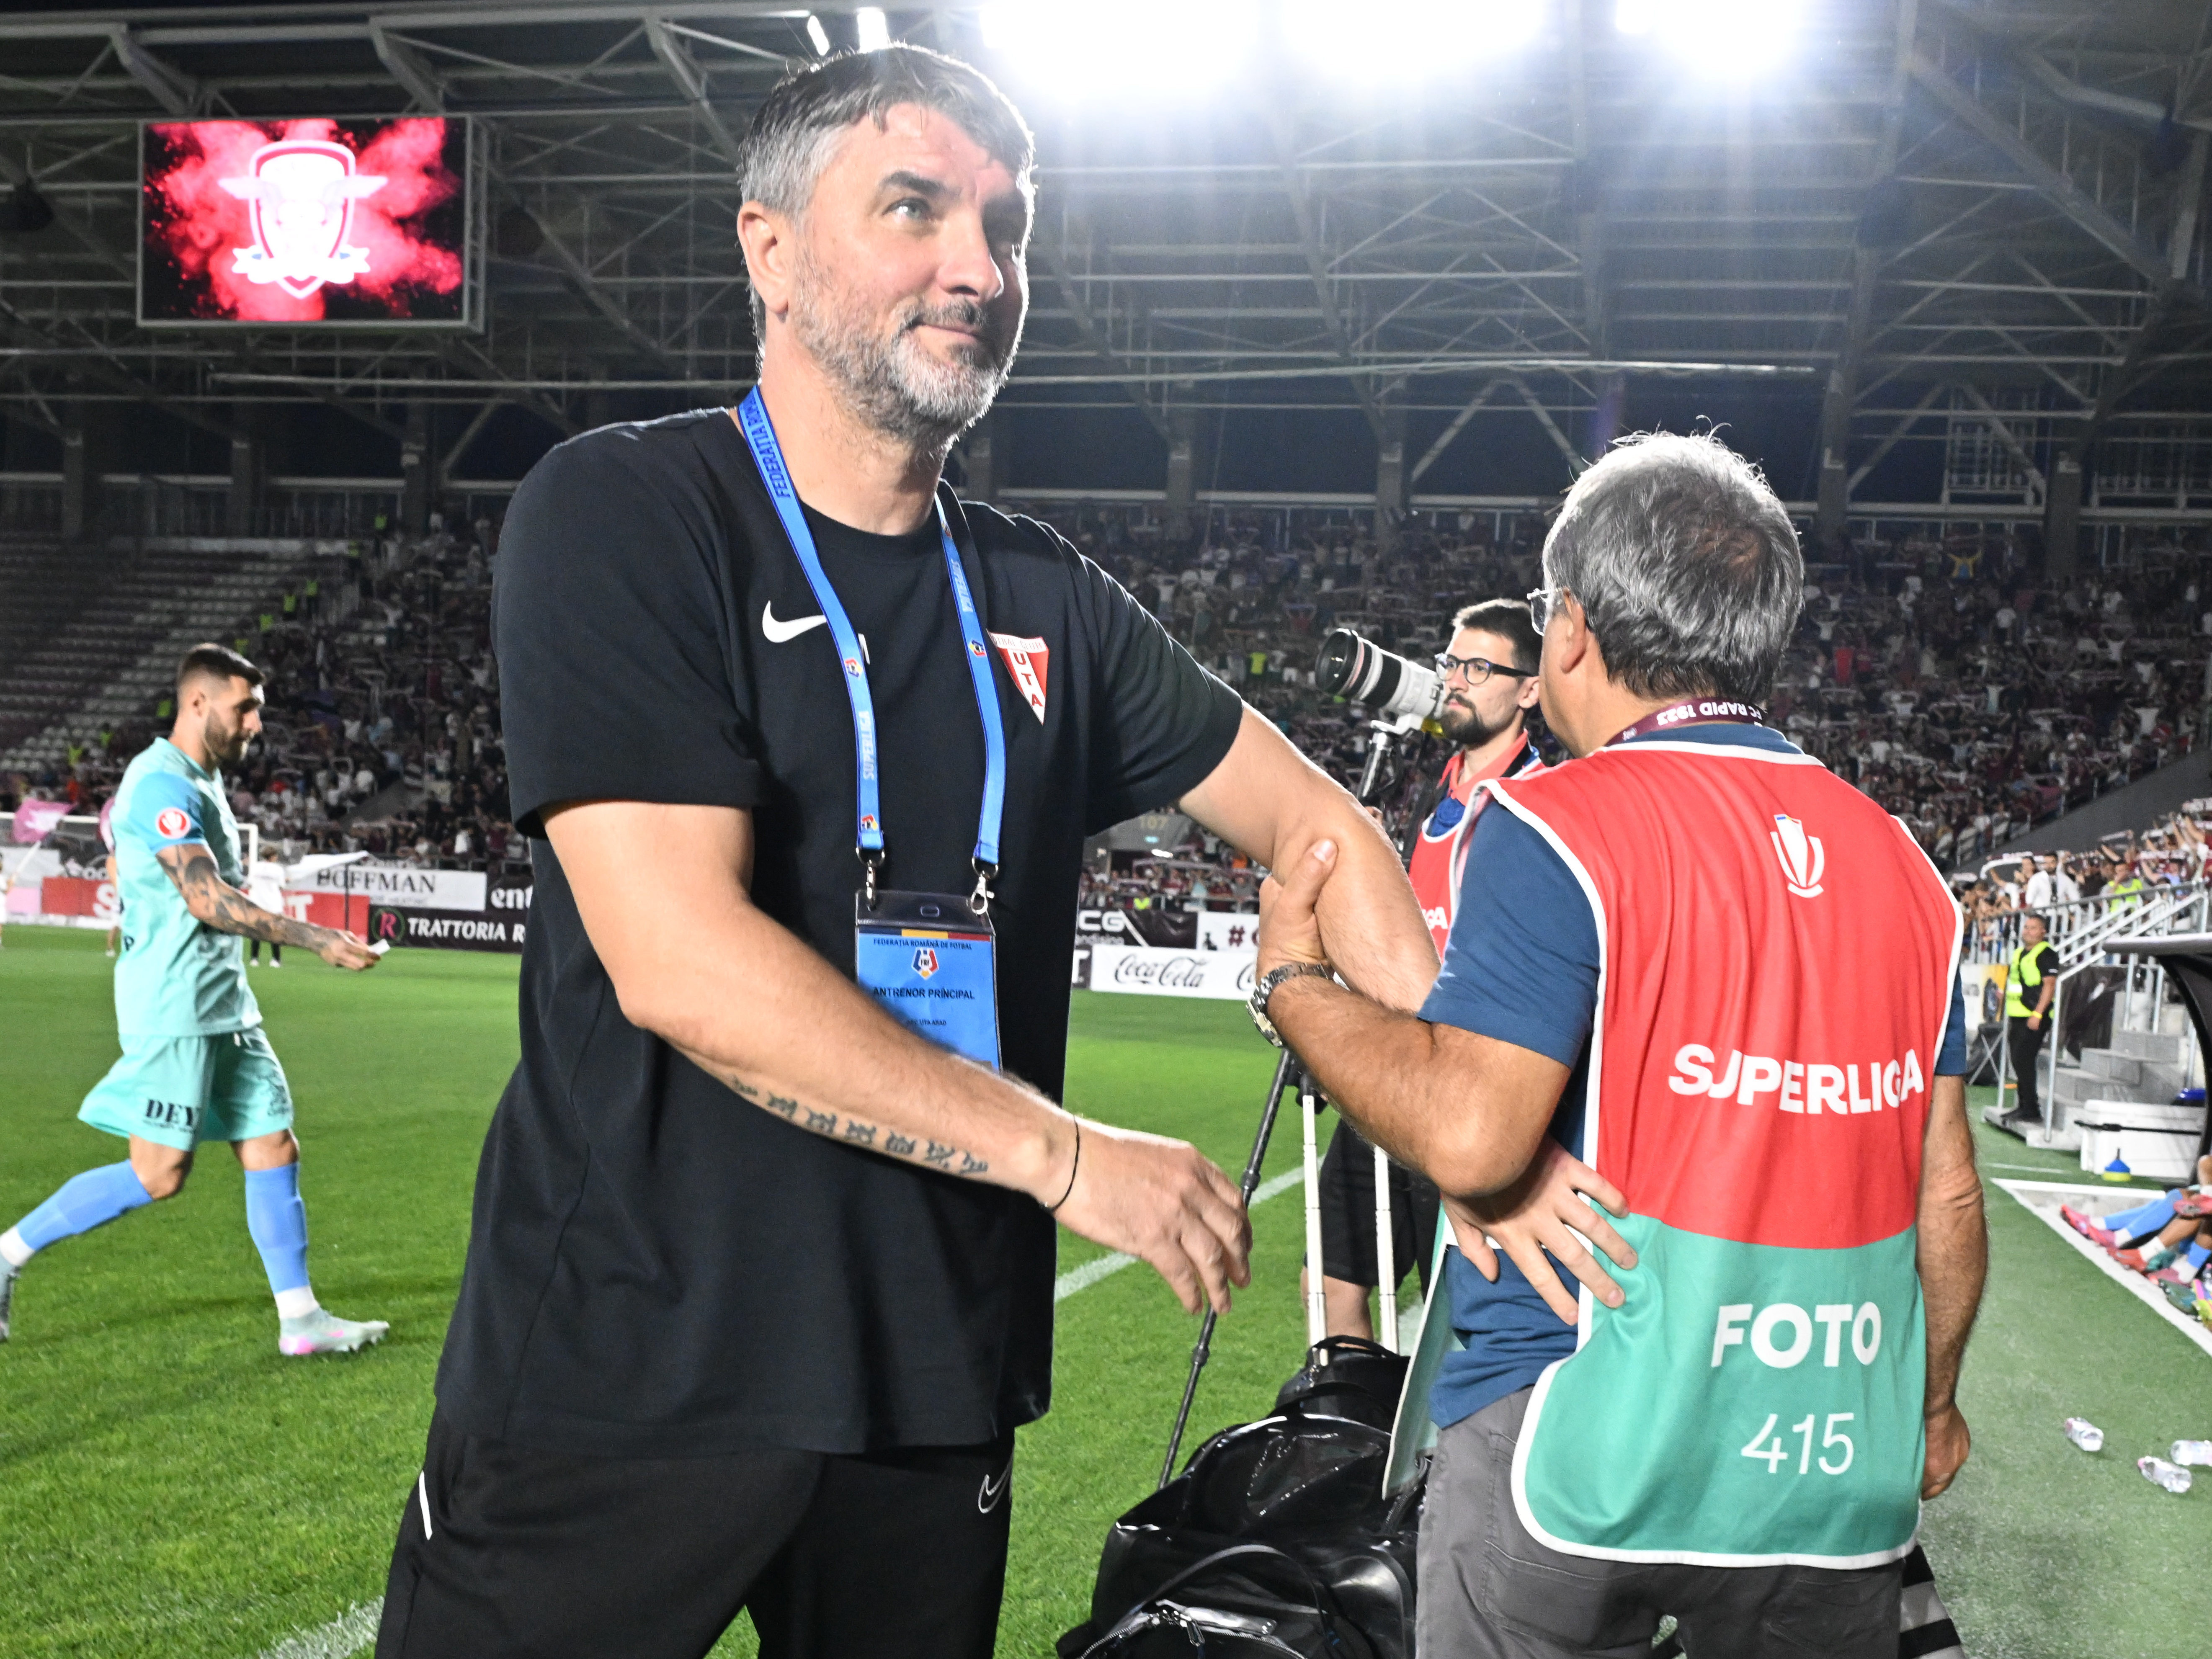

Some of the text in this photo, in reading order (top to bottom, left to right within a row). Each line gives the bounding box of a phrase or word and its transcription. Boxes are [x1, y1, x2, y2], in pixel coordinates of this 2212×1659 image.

[1013, 651, 1044, 707] UTA
[1656, 704, 1696, 726] 1923
[1699, 702, 1748, 716] RAPID
[407, 917, 506, 942] TRATTORIA
[873, 987, 926, 998] ANTRENOR
[1710, 1301, 1882, 1368] FOTO
[1740, 1412, 1855, 1475] 415
